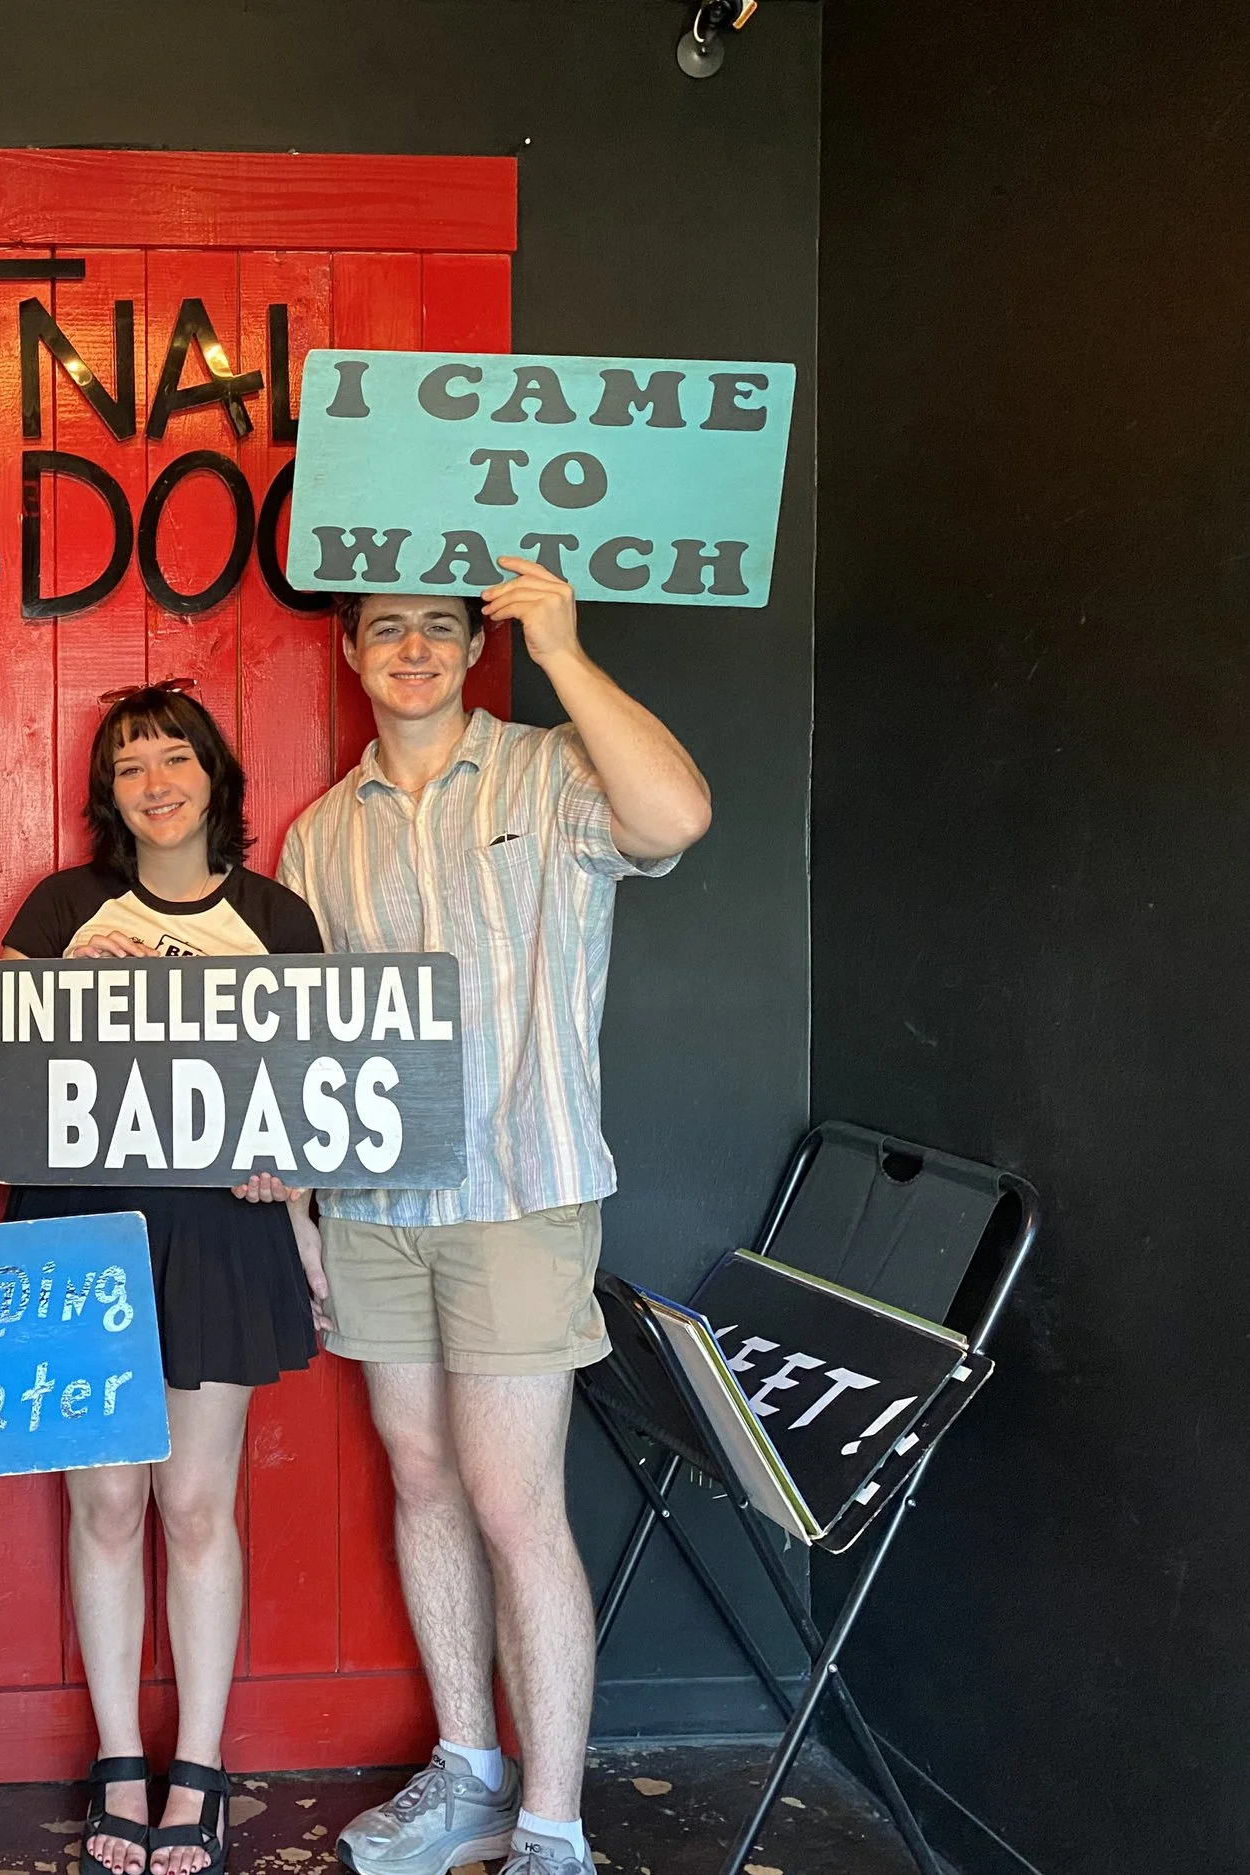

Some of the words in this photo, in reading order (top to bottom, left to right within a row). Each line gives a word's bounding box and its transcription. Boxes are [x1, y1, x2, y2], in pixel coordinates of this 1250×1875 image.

[326, 360, 370, 418] I
[418, 363, 769, 431] CAME
[469, 448, 608, 509] TO
[311, 525, 750, 596] WATCH
[1, 966, 454, 1044] INTELLECTUAL
[47, 1056, 404, 1175] BADASS
[714, 1324, 919, 1456] EET!
